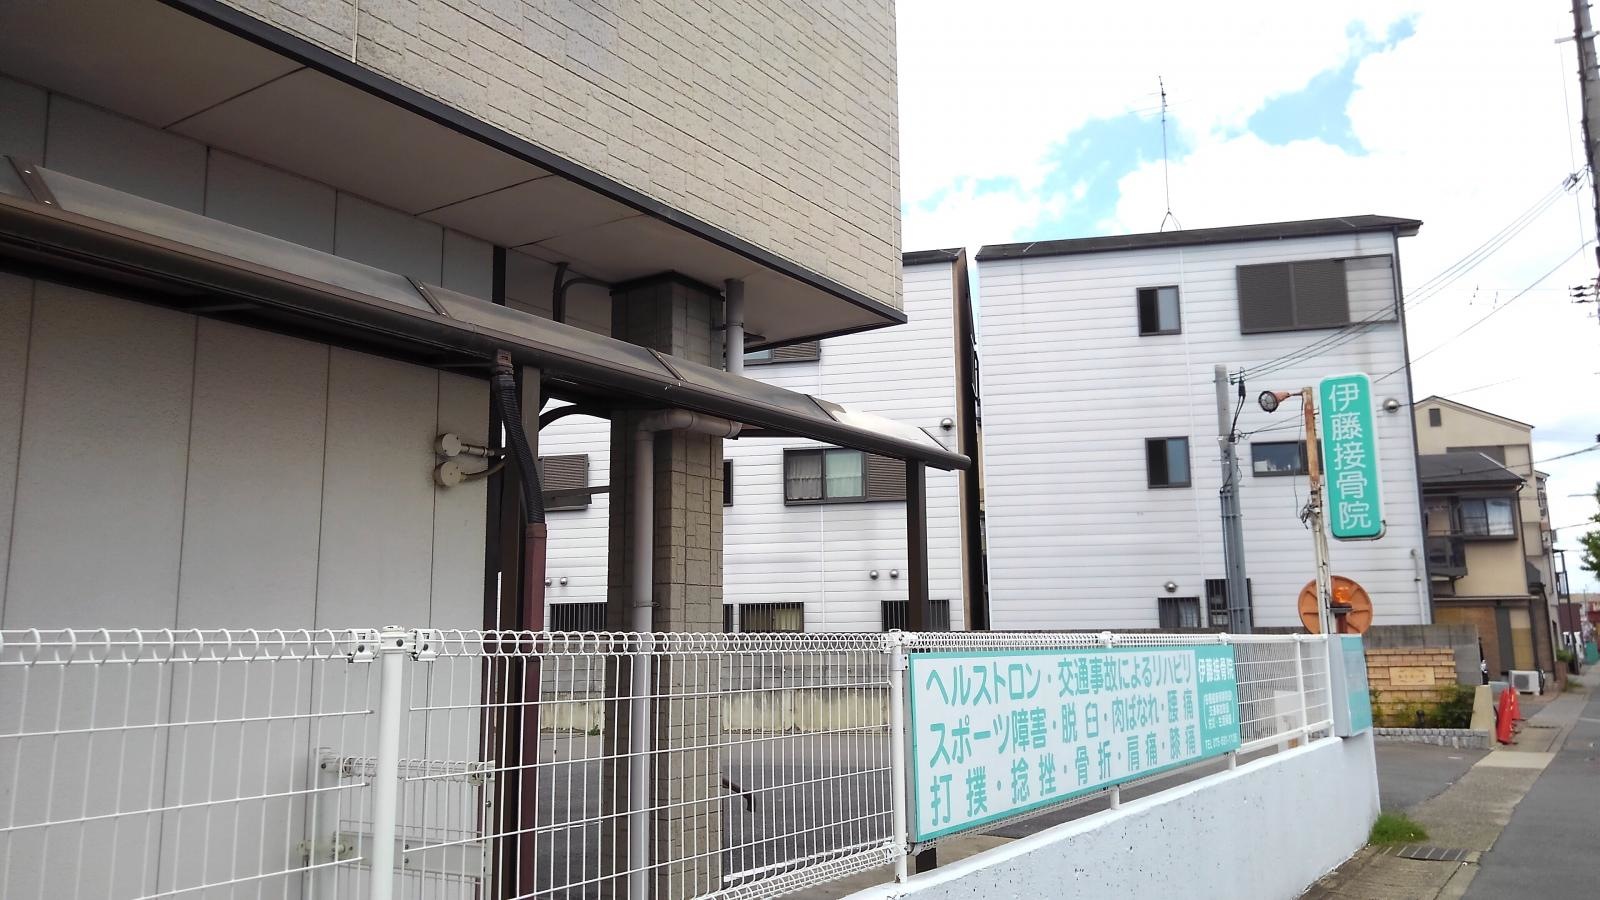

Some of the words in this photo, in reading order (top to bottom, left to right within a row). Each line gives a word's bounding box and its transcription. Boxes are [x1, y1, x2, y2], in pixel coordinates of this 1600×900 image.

[1329, 383, 1371, 530] 伊藤接骨院
